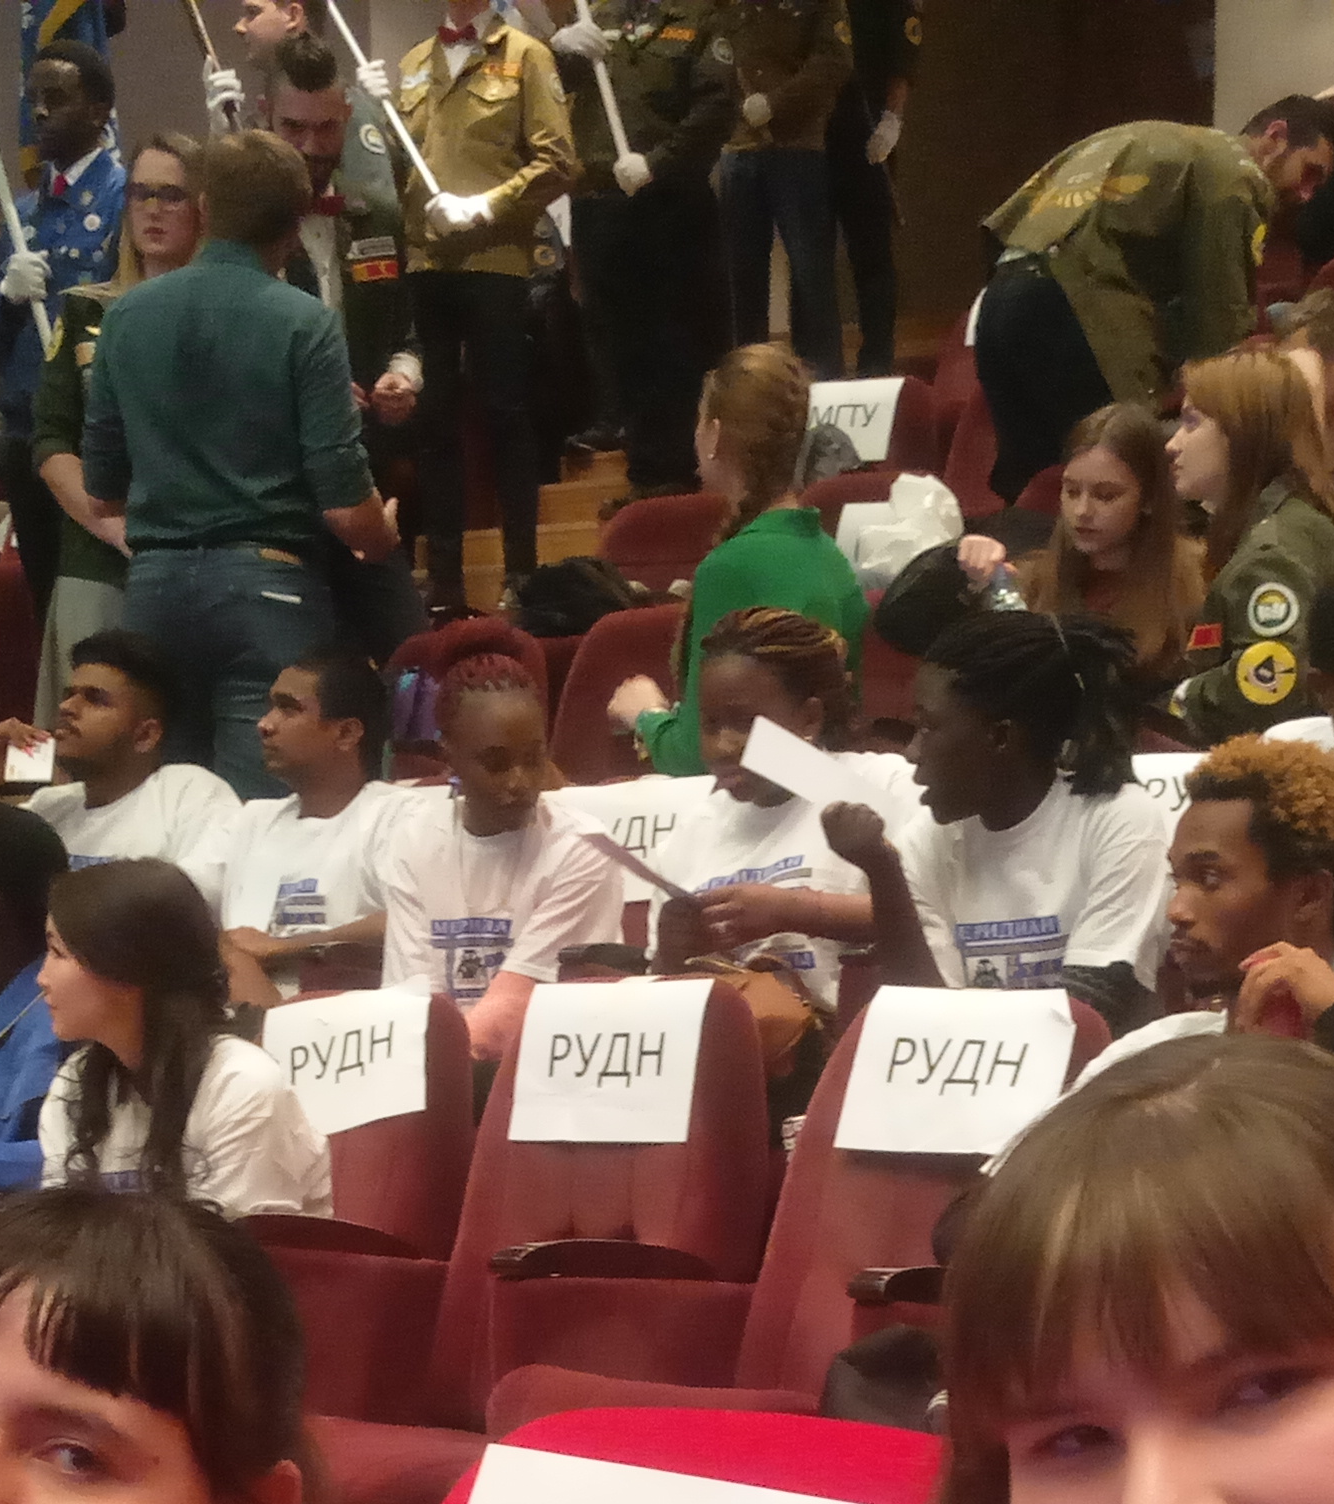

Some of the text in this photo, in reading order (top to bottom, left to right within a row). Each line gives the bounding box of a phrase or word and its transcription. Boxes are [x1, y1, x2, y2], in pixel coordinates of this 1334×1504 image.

[807, 402, 881, 428] МГТУ
[291, 1021, 395, 1085] РУДН
[548, 1032, 666, 1087] РУДН
[887, 1037, 1029, 1096] РУДН
